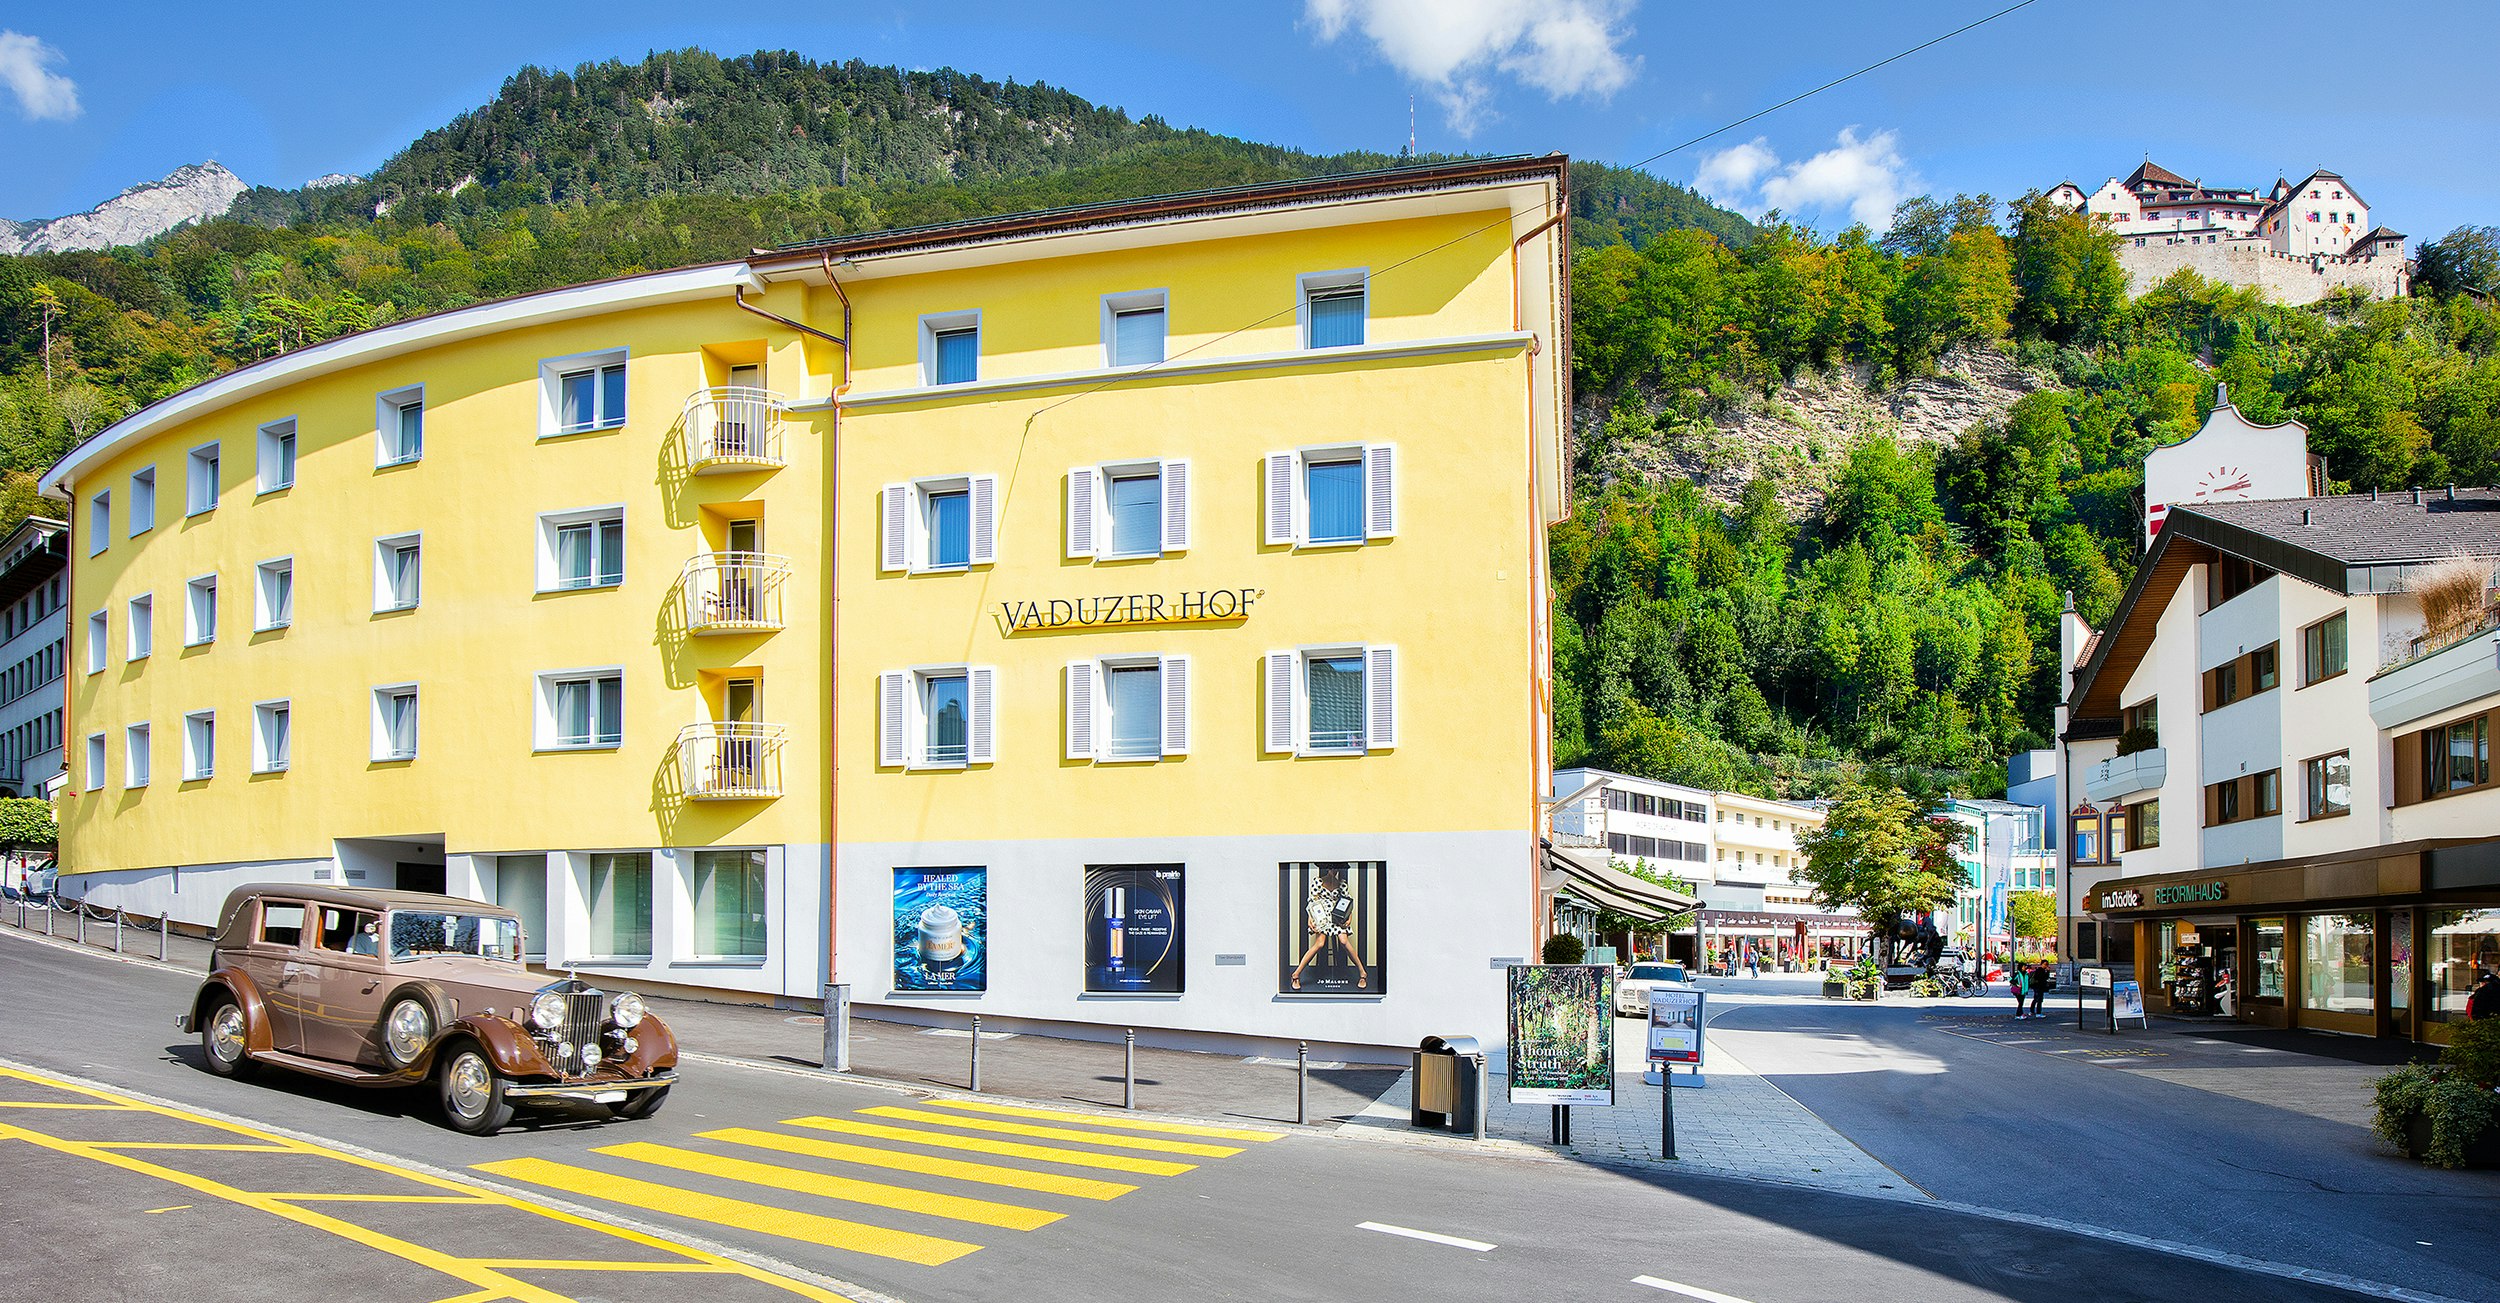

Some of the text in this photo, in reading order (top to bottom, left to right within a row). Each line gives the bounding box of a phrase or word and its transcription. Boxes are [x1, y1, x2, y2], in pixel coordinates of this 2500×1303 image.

[1001, 589, 1255, 630] VADUZER HOF
[923, 874, 958, 882] HEALED
[917, 883, 928, 891] BY
[929, 883, 947, 891] THE
[2154, 881, 2222, 904] REFORMHAUS
[937, 972, 956, 980] MER
[1518, 1044, 1570, 1056] Thomas
[1517, 1057, 1561, 1069] Struth
